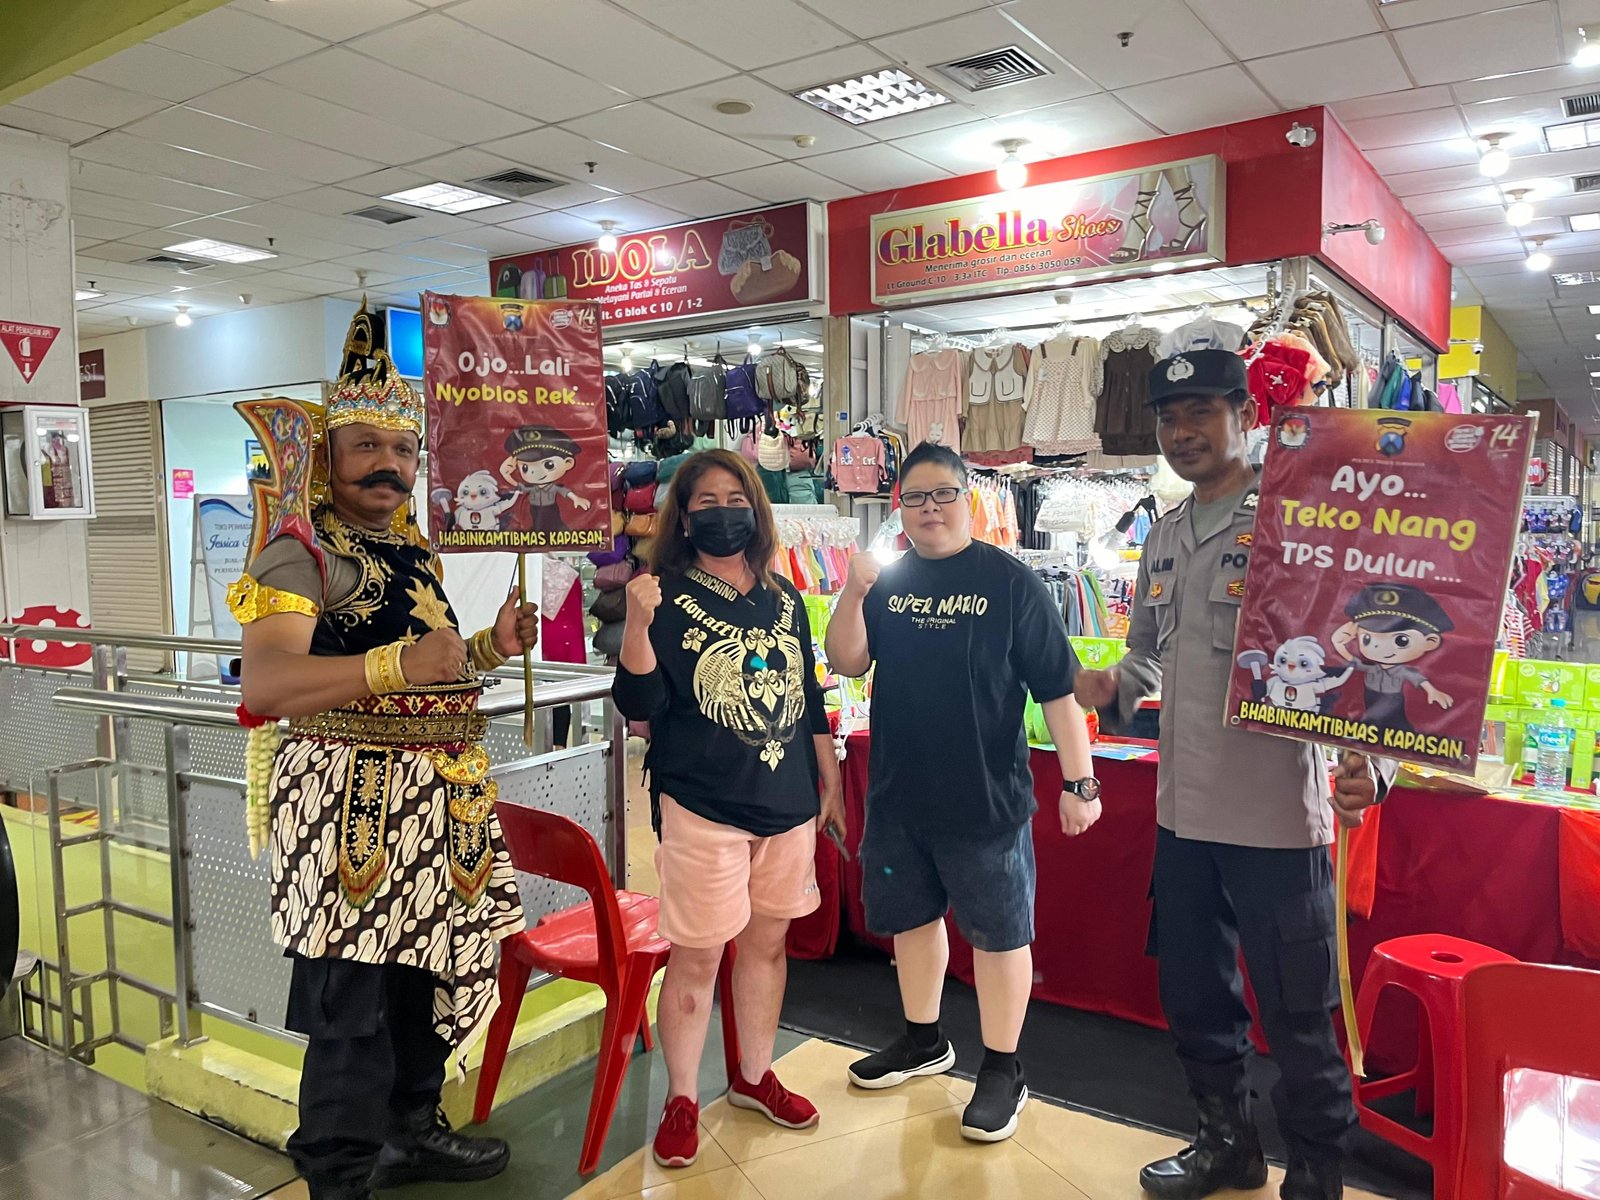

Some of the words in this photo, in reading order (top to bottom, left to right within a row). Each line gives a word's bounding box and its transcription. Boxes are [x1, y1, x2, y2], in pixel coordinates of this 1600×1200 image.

[878, 209, 1053, 266] Glabella
[1056, 213, 1123, 242] Shoes
[572, 229, 711, 289] IDOLA
[924, 261, 968, 273] Menerima
[970, 257, 996, 271] grosir
[1000, 253, 1017, 263] dan
[1020, 249, 1051, 260] eceran
[604, 283, 628, 294] Aneka
[630, 281, 643, 289] Tas
[651, 276, 677, 288] Sepatu
[896, 278, 926, 289] Ground
[974, 269, 988, 278] ITC
[1014, 264, 1035, 273] 0856
[1039, 260, 1061, 270] 3050
[1063, 257, 1081, 266] 059
[630, 288, 653, 300] Partai
[661, 285, 688, 295] Eceran
[614, 308, 623, 318] G
[625, 306, 648, 316] blok
[649, 304, 657, 314] C
[660, 302, 673, 312] 10
[687, 297, 703, 309] 1-2
[435, 382, 528, 407] Nyoblos
[1331, 464, 1427, 502] Ayo...
[1281, 499, 1362, 531] Teko
[1373, 507, 1477, 552] Nang
[205, 534, 240, 551] Jessica
[438, 529, 547, 547] BHABINKAMTIBMAS
[1281, 541, 1335, 569] TPS
[888, 594, 931, 614] SUPER
[937, 594, 988, 616] MARIO
[911, 616, 925, 624] THE
[1240, 701, 1379, 744] BHABINKAMTIBMAS
